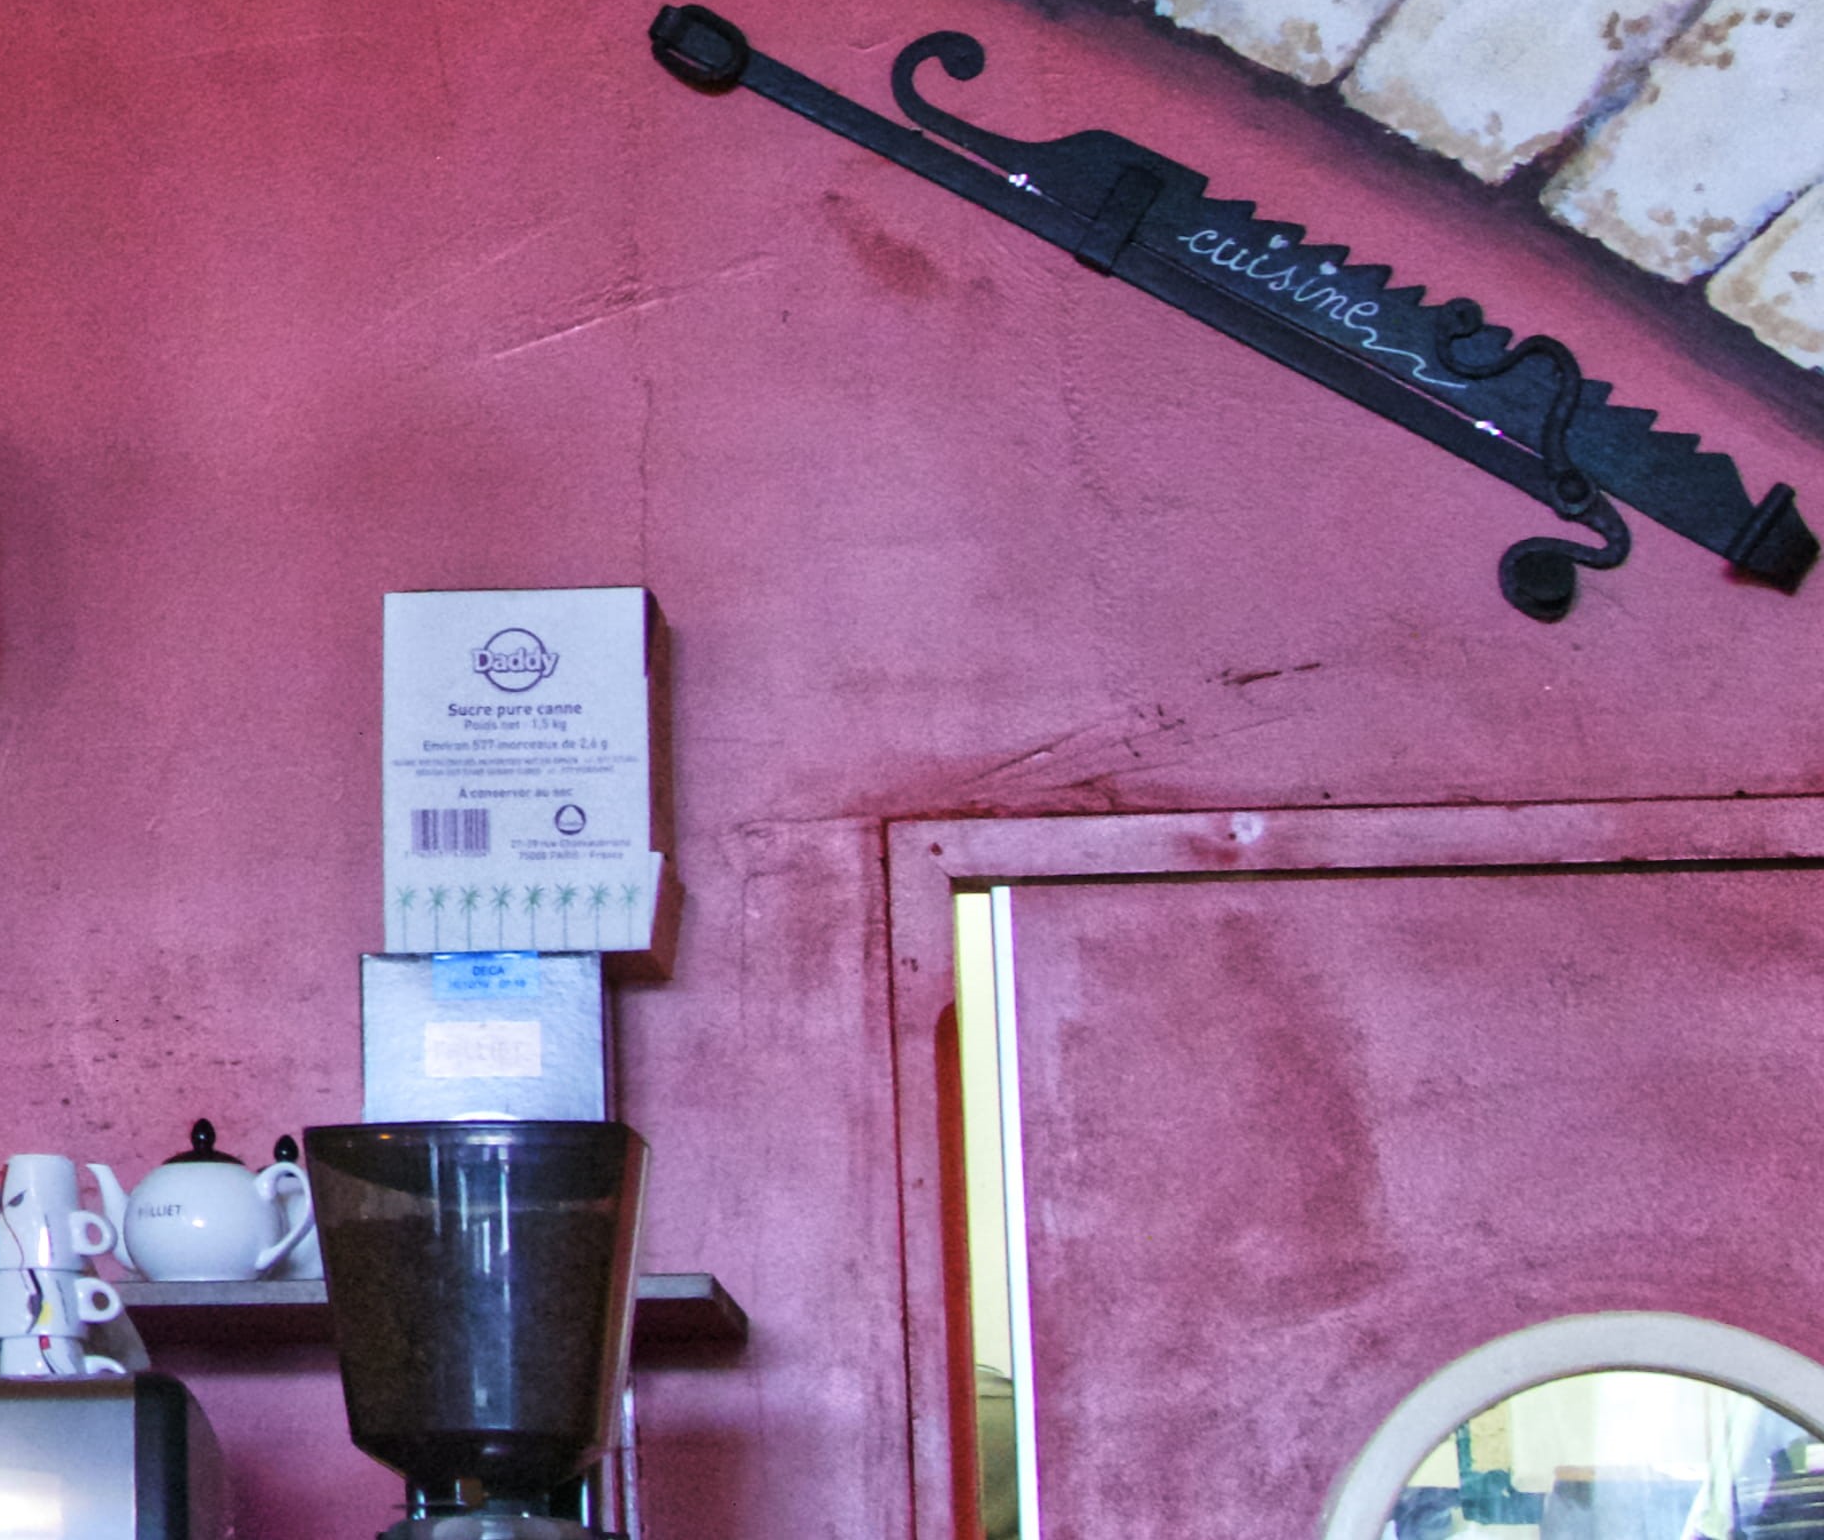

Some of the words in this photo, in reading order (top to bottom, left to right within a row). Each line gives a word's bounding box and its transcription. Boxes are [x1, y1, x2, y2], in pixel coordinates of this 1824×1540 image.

[1178, 228, 1380, 348] cuisine
[472, 646, 559, 678] Daddy
[448, 703, 492, 716] Sucre
[497, 705, 532, 719] pure
[536, 703, 582, 715] canne
[473, 966, 504, 975] DECA
